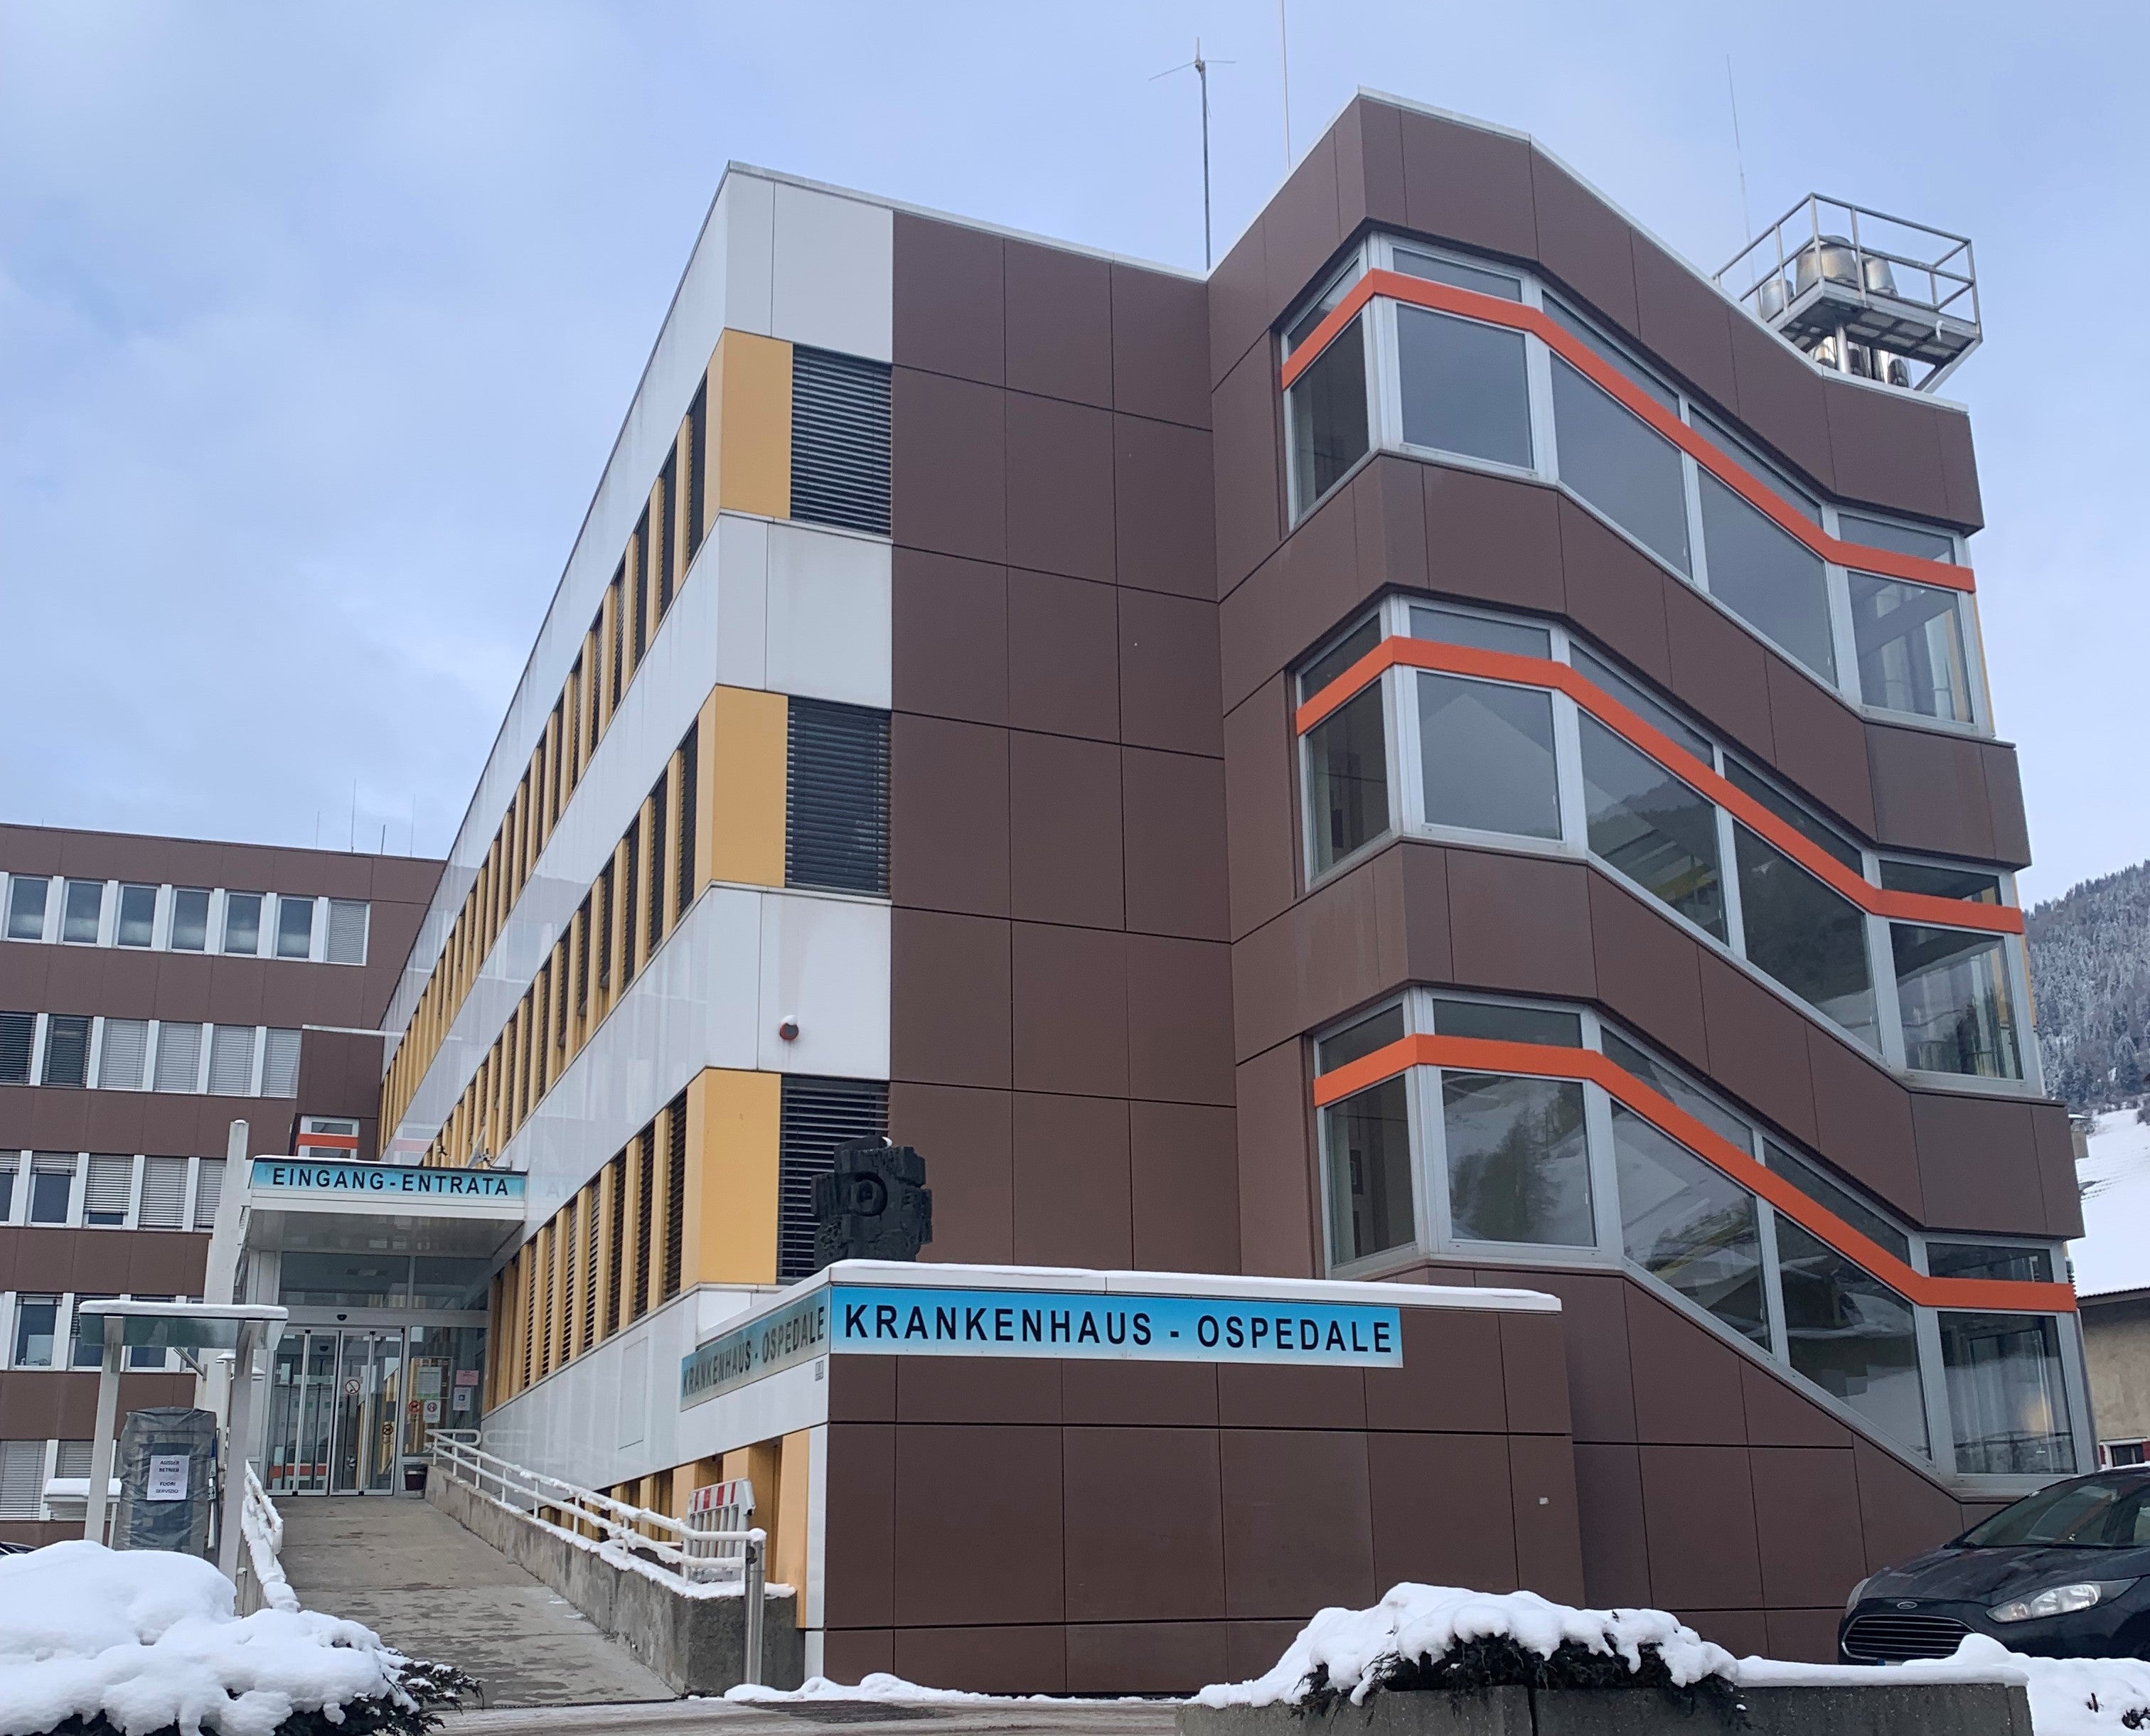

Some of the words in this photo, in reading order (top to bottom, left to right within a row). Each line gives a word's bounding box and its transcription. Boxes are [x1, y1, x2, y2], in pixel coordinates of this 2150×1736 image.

[683, 1340, 752, 1398] KRANKENHAUS
[762, 1306, 825, 1364] OSPEDALE
[845, 1304, 1152, 1346] KRANKENHAUS
[1197, 1315, 1391, 1353] OSPEDALE
